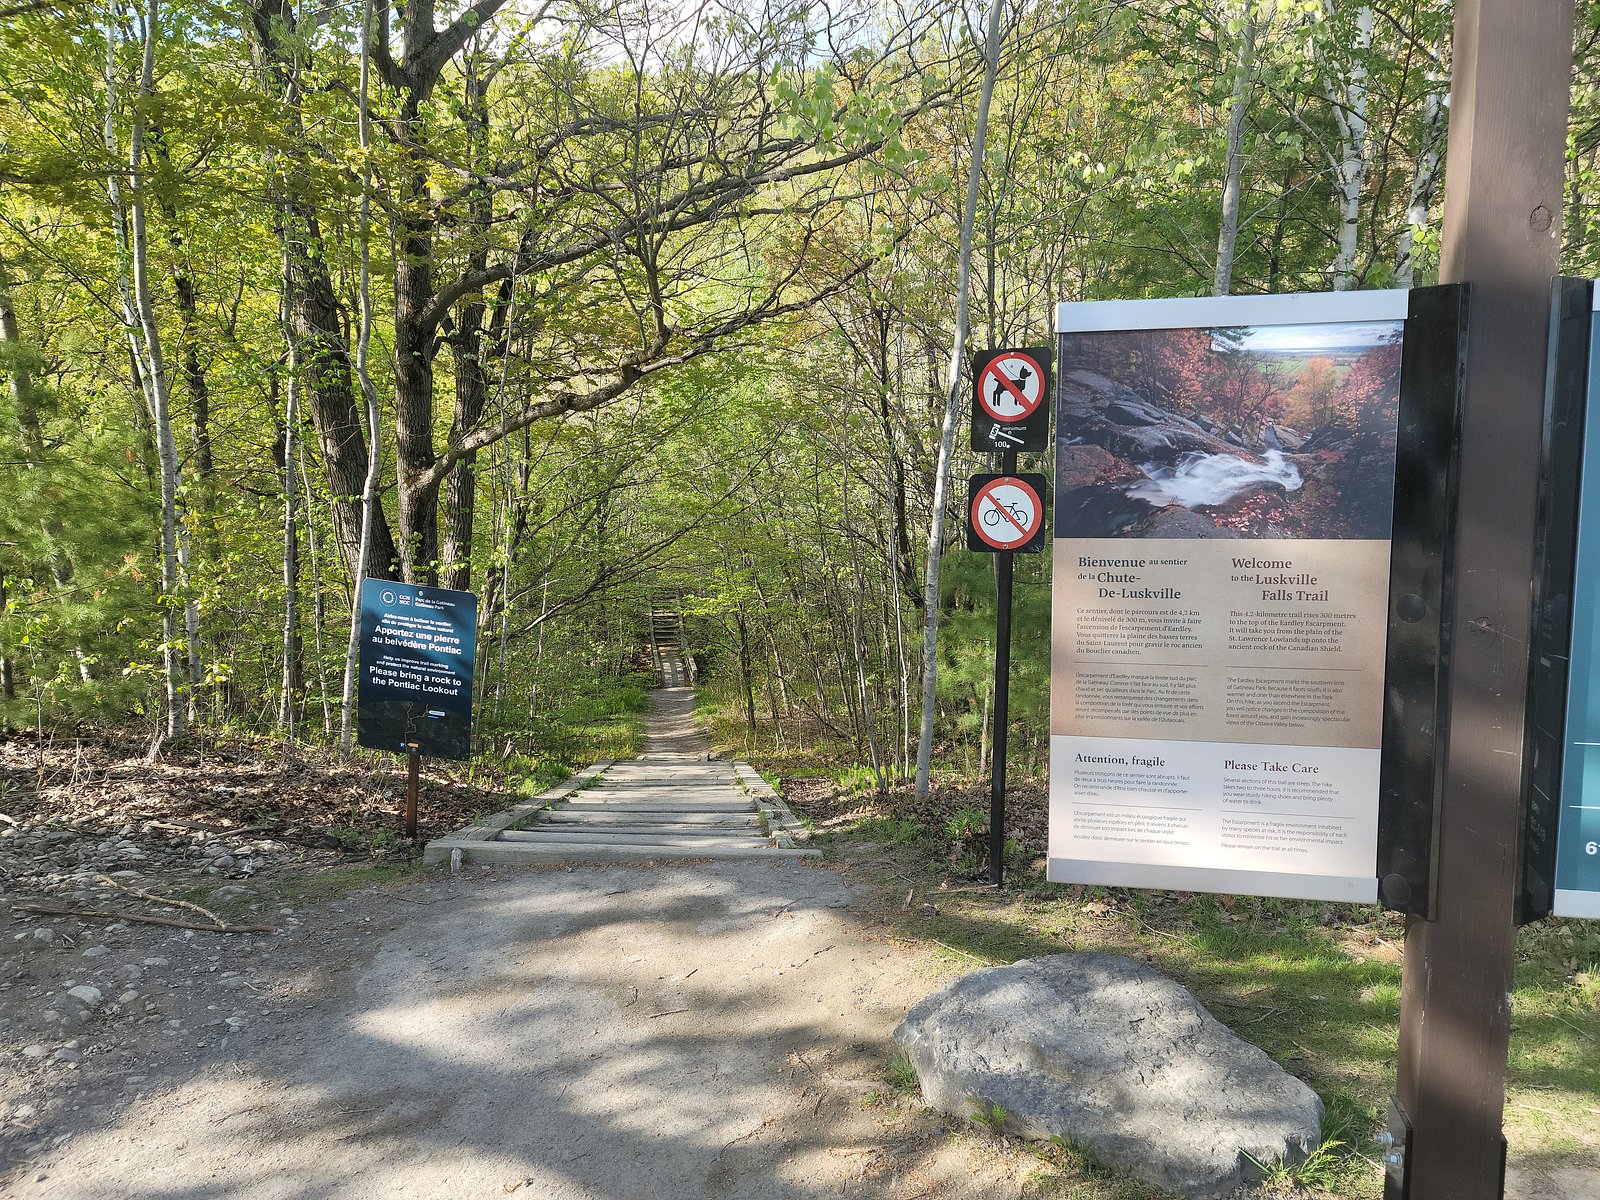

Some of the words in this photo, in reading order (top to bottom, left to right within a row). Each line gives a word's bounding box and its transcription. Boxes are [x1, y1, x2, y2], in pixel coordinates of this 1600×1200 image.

[1078, 557, 1145, 568] Bienvenue
[1160, 558, 1187, 566] sentier
[1232, 558, 1292, 569] Welcome
[1097, 572, 1141, 583] Chute-
[1240, 574, 1254, 582] the
[1256, 574, 1317, 585] Luskville
[1099, 588, 1181, 599] De-Luskville
[1262, 590, 1293, 601] Falls
[1296, 590, 1328, 601] Trail
[1086, 608, 1108, 616] sentier,
[1179, 609, 1188, 617] 4,2
[1119, 624, 1161, 633] l'escarpement
[1162, 625, 1192, 634] d'Eardley.
[1249, 619, 1259, 627] top
[1280, 619, 1304, 628] Eardley
[1306, 620, 1346, 629] Escarpment.
[375, 625, 414, 638] Apportez
[415, 632, 432, 641] une
[434, 634, 460, 645] pierre
[1092, 632, 1119, 640] quitterez
[1127, 632, 1146, 641] plaine
[1306, 628, 1322, 637] plain
[385, 637, 427, 650] belvédère
[428, 642, 462, 655] Pontiac
[1145, 641, 1163, 650] gravir
[369, 666, 397, 677] Please
[399, 670, 422, 682] bring
[431, 675, 451, 685] rock
[452, 678, 462, 686] to
[427, 667, 456, 676] environment
[372, 677, 386, 685] the
[388, 679, 420, 690] Pontiac
[422, 684, 458, 696] Lookout
[1075, 753, 1128, 766] Attention,
[1132, 756, 1166, 768] fragile
[1224, 760, 1258, 771] Please
[1261, 762, 1288, 772] Take
[1292, 762, 1319, 774] Care
[1585, 841, 1600, 856] 6
